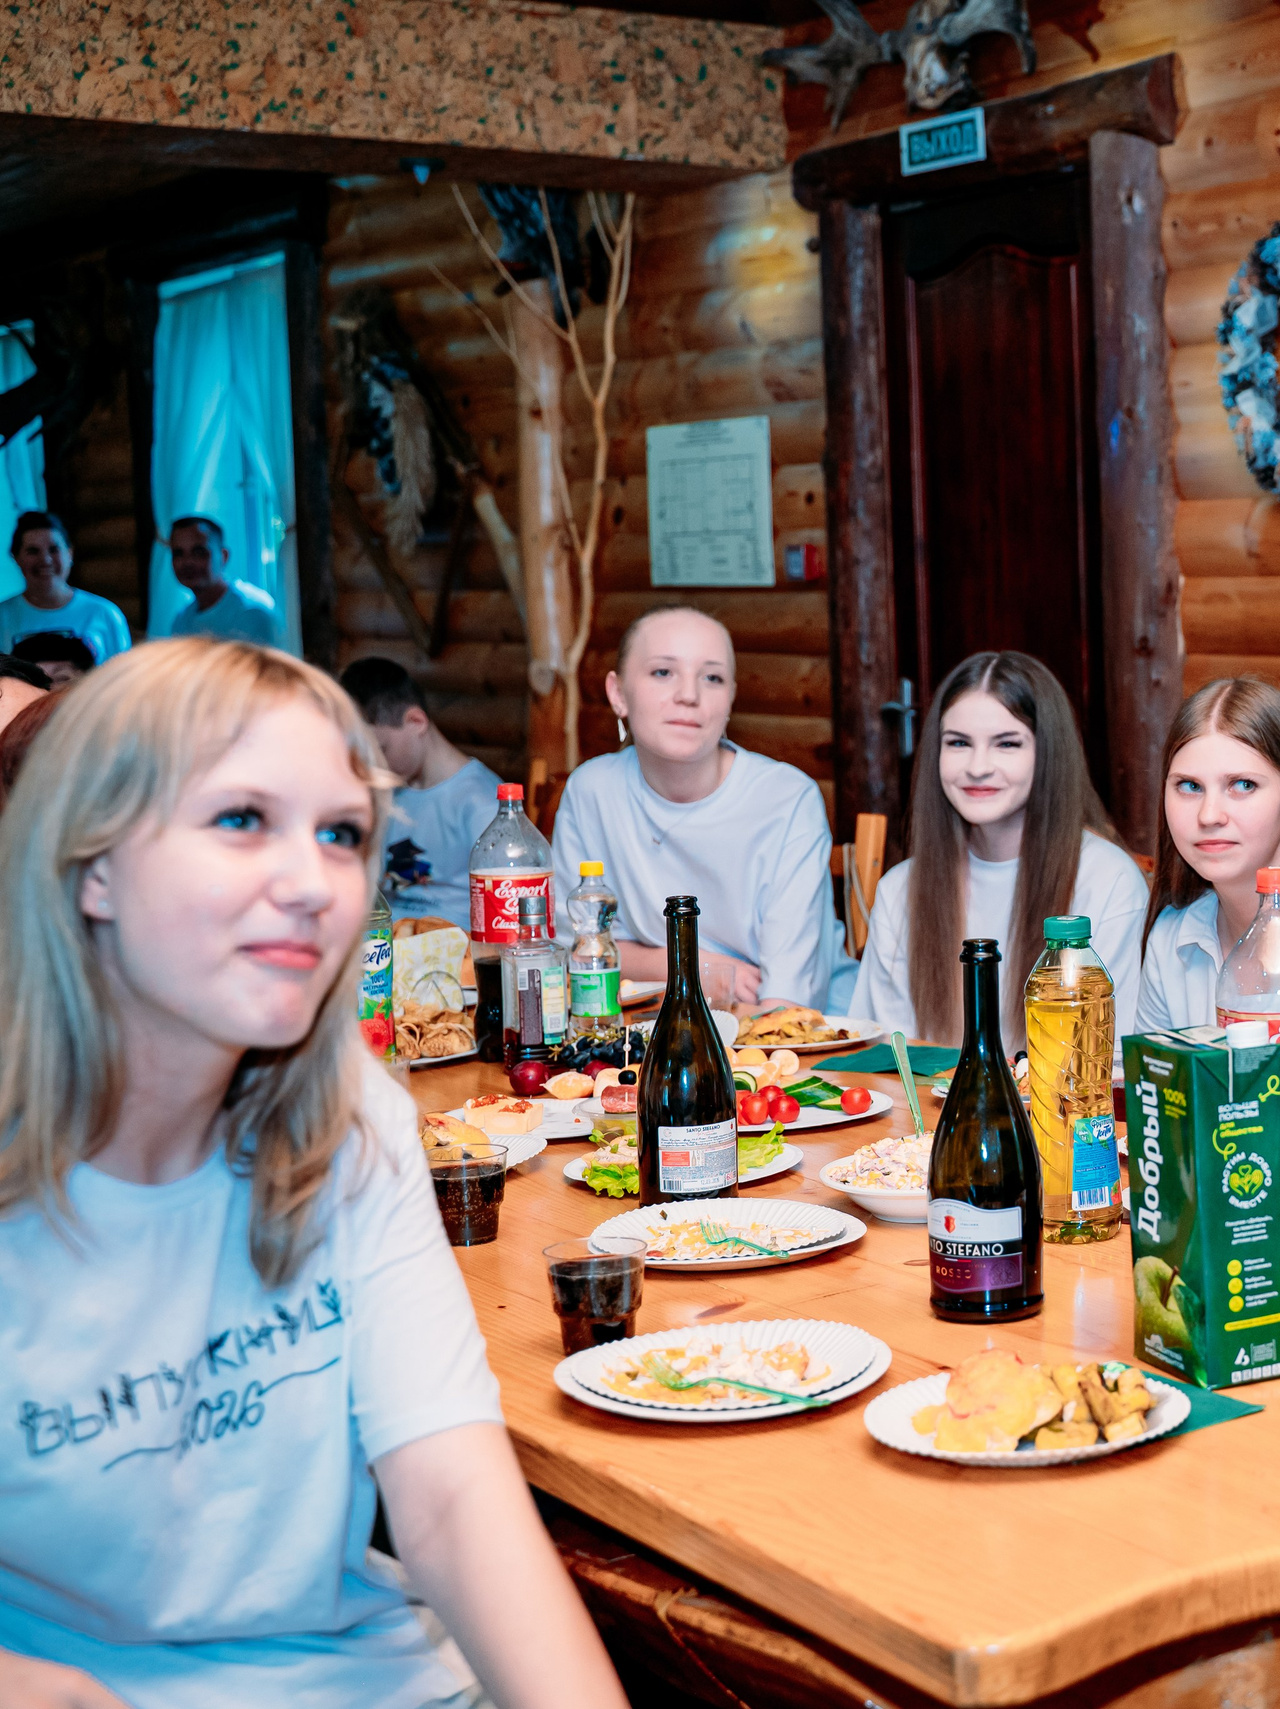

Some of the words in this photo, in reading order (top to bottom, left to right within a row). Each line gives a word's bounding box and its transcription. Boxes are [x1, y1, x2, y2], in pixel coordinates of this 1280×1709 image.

[910, 121, 975, 164] ВЫХОД
[494, 878, 548, 899] Export
[491, 915, 519, 930] Class
[1163, 1087, 1187, 1108] 100%
[1135, 1079, 1164, 1243] Добрый
[1248, 1152, 1273, 1187] ДОБРО
[1222, 1151, 1246, 1193] РАСТИМ
[1228, 1189, 1269, 1209] ВМЕСТЕ
[946, 1242, 1004, 1256] STEFANO
